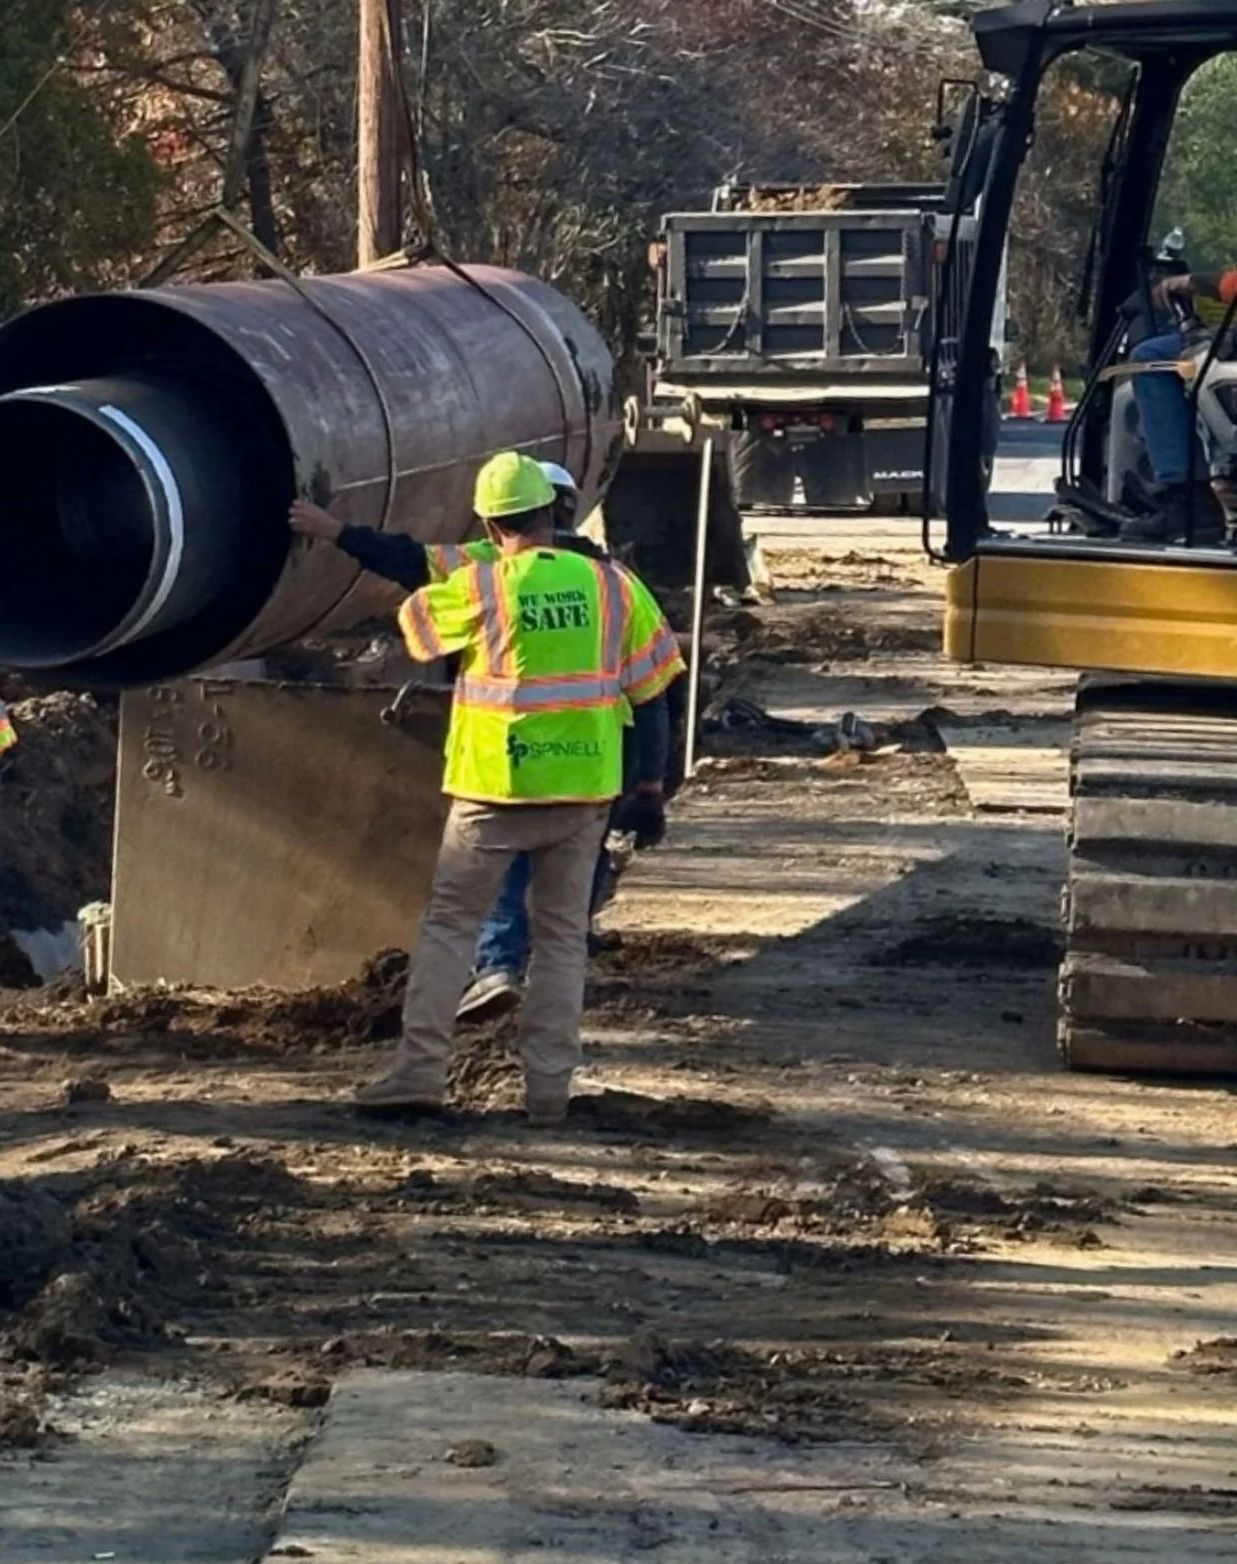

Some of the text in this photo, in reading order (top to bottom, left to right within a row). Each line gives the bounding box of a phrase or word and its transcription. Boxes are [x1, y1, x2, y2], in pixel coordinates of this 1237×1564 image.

[544, 588, 587, 604] WORK
[520, 603, 590, 632] SAFE
[530, 740, 605, 758] SPINELL
